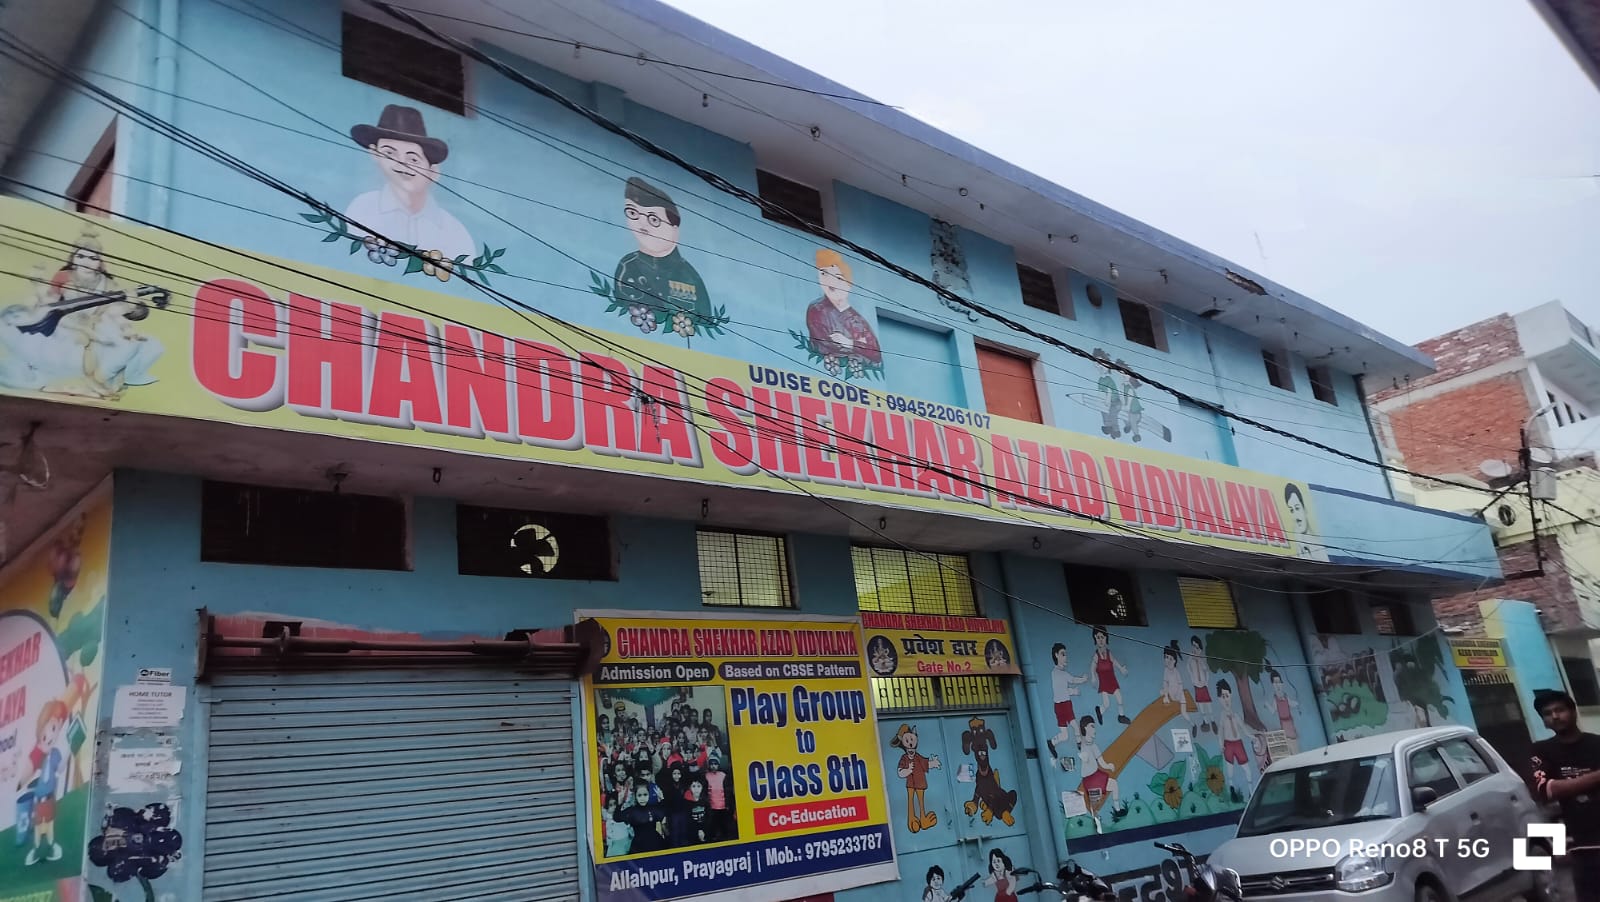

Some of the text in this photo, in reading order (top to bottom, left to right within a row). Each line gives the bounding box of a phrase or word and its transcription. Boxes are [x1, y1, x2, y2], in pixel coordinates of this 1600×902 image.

[749, 365, 811, 394] UDISE
[817, 380, 870, 405] CODE
[886, 394, 991, 430] 09452206107
[192, 278, 1290, 549] CHANDRA SHEKHAR AZAD VIDYALAYA
[616, 627, 692, 658] CHANDRA
[693, 628, 759, 657] SHEKHAR
[759, 629, 794, 657] AZAD
[794, 629, 859, 657] VIDYALAYA
[901, 634, 978, 656] प्रवेश द्वार
[600, 665, 710, 682] Admission Open
[724, 663, 856, 678] Based on CBSE Pattern
[917, 660, 972, 673] Gate No.2
[731, 685, 866, 728] Play Group
[796, 728, 815, 754] to
[748, 753, 869, 801] Class 8th
[768, 805, 857, 828] Co-Education
[609, 832, 883, 893] Allahpur, Prayagraj Mob.: 9795233787
